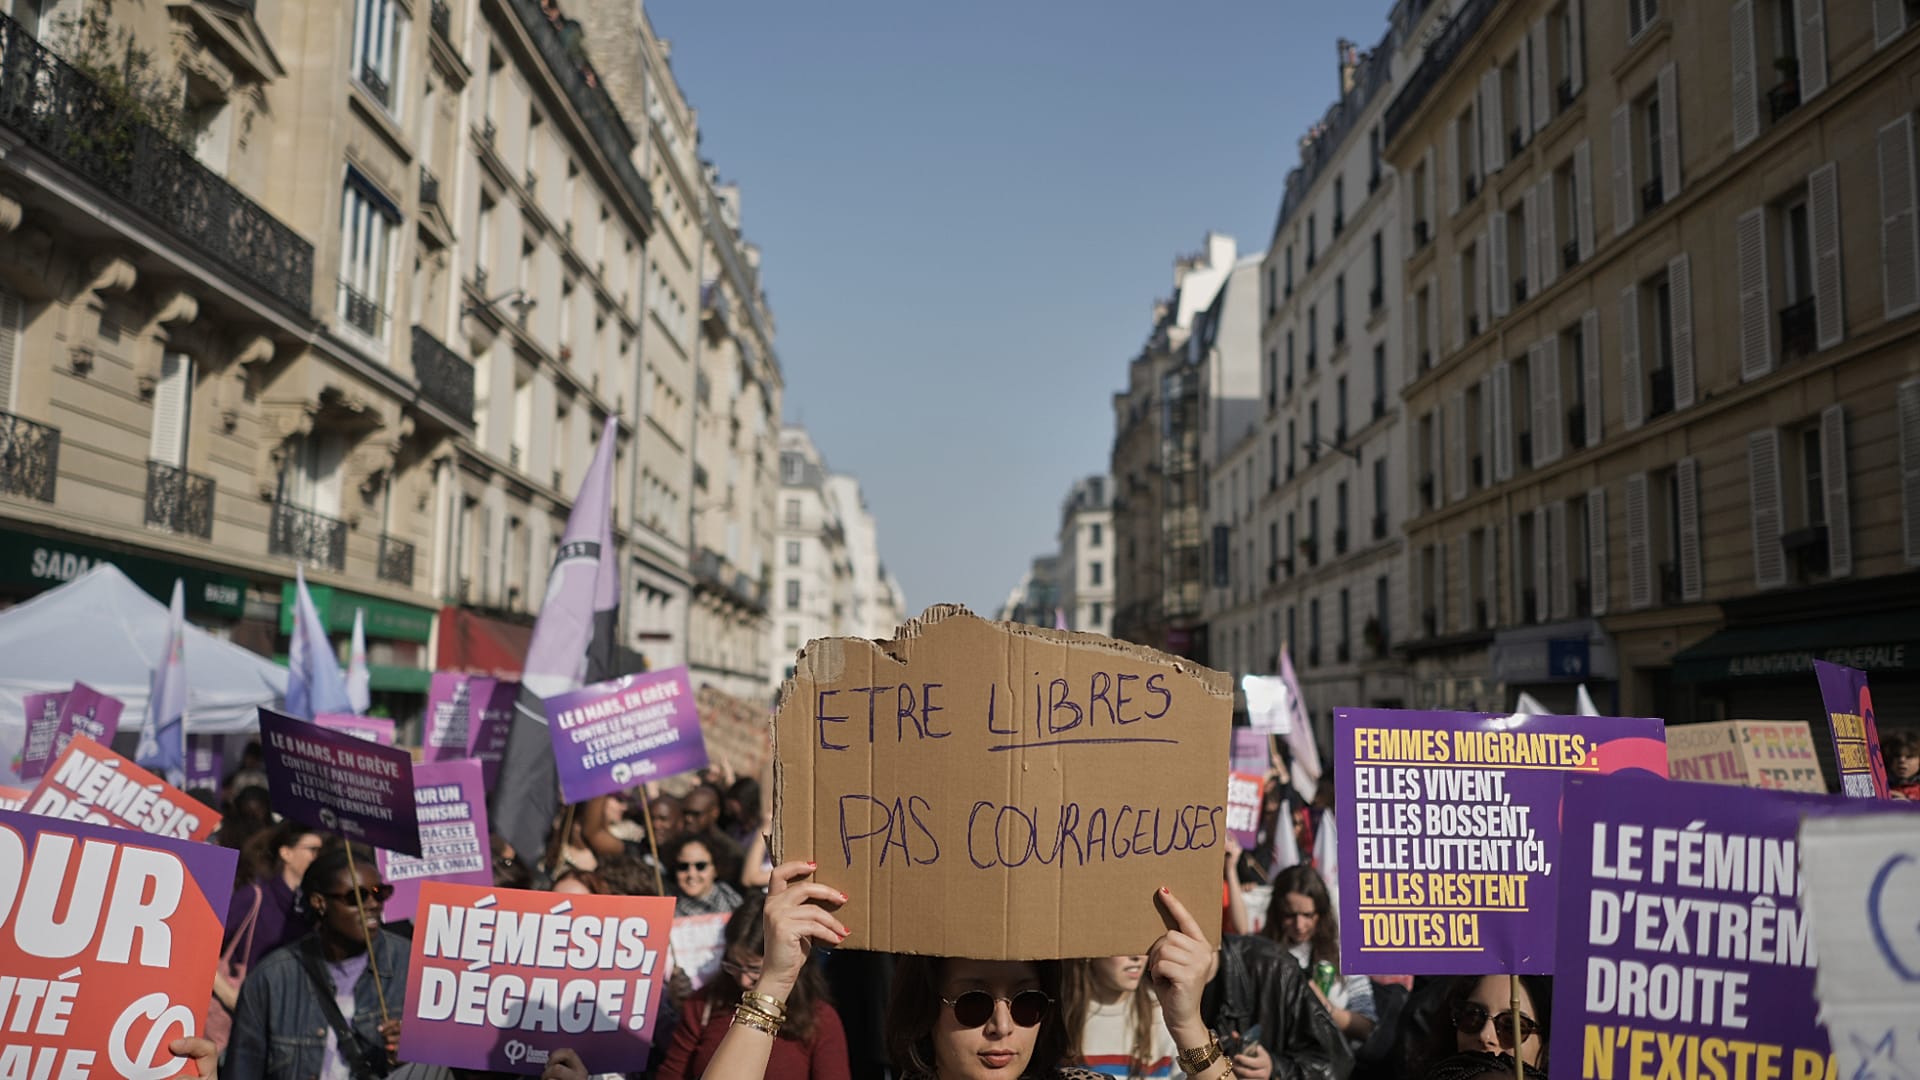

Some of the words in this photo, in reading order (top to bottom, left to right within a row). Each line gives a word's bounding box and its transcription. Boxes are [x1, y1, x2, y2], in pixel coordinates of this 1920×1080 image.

[31, 549, 101, 582] SADA
[557, 710, 575, 730] LE
[583, 698, 625, 722] MARS,
[623, 691, 642, 710] EN
[640, 680, 680, 705] GRÈVE
[816, 683, 952, 751] ETRE
[570, 723, 608, 744] CONTRE
[608, 718, 621, 732] LE
[1354, 728, 1450, 762] FEMMES
[1453, 730, 1585, 766] MIGRANTES
[1750, 726, 1812, 758] FREE
[270, 731, 284, 749] LE
[295, 738, 336, 766] MARS,
[337, 750, 355, 768] EN
[357, 756, 399, 778] GRÈVE
[582, 755, 595, 770] ET
[595, 751, 610, 765] CE
[1668, 750, 1749, 781] UNTIL
[281, 754, 317, 775] CONTRE
[318, 765, 329, 777] LE
[331, 769, 394, 795] PATRIARCAT,
[438, 784, 460, 802] UN
[1355, 767, 1420, 800] ELLES
[1423, 769, 1511, 805] VIVENT,
[291, 783, 304, 797] ET
[304, 788, 317, 800] CE
[318, 791, 393, 821] GOUVERNEMENT
[839, 795, 940, 868] PAS
[968, 802, 1224, 869] COURAGEUSES
[1355, 803, 1422, 836] ELLES
[1425, 804, 1535, 841] BOSSENT,
[1357, 838, 1409, 870] ELLE
[1412, 838, 1512, 871] LUTTENT
[1516, 840, 1552, 876] ICI,
[1591, 823, 1644, 882] LE
[1359, 872, 1424, 905] ELLES
[1428, 873, 1528, 906] RESTENT
[423, 894, 657, 975] NÉMÉSIS,
[1359, 913, 1446, 946] TOUTES
[1449, 914, 1479, 946] ICI
[1585, 956, 1750, 1029] DROITE
[1582, 1024, 1783, 1080] N'EXISTE
